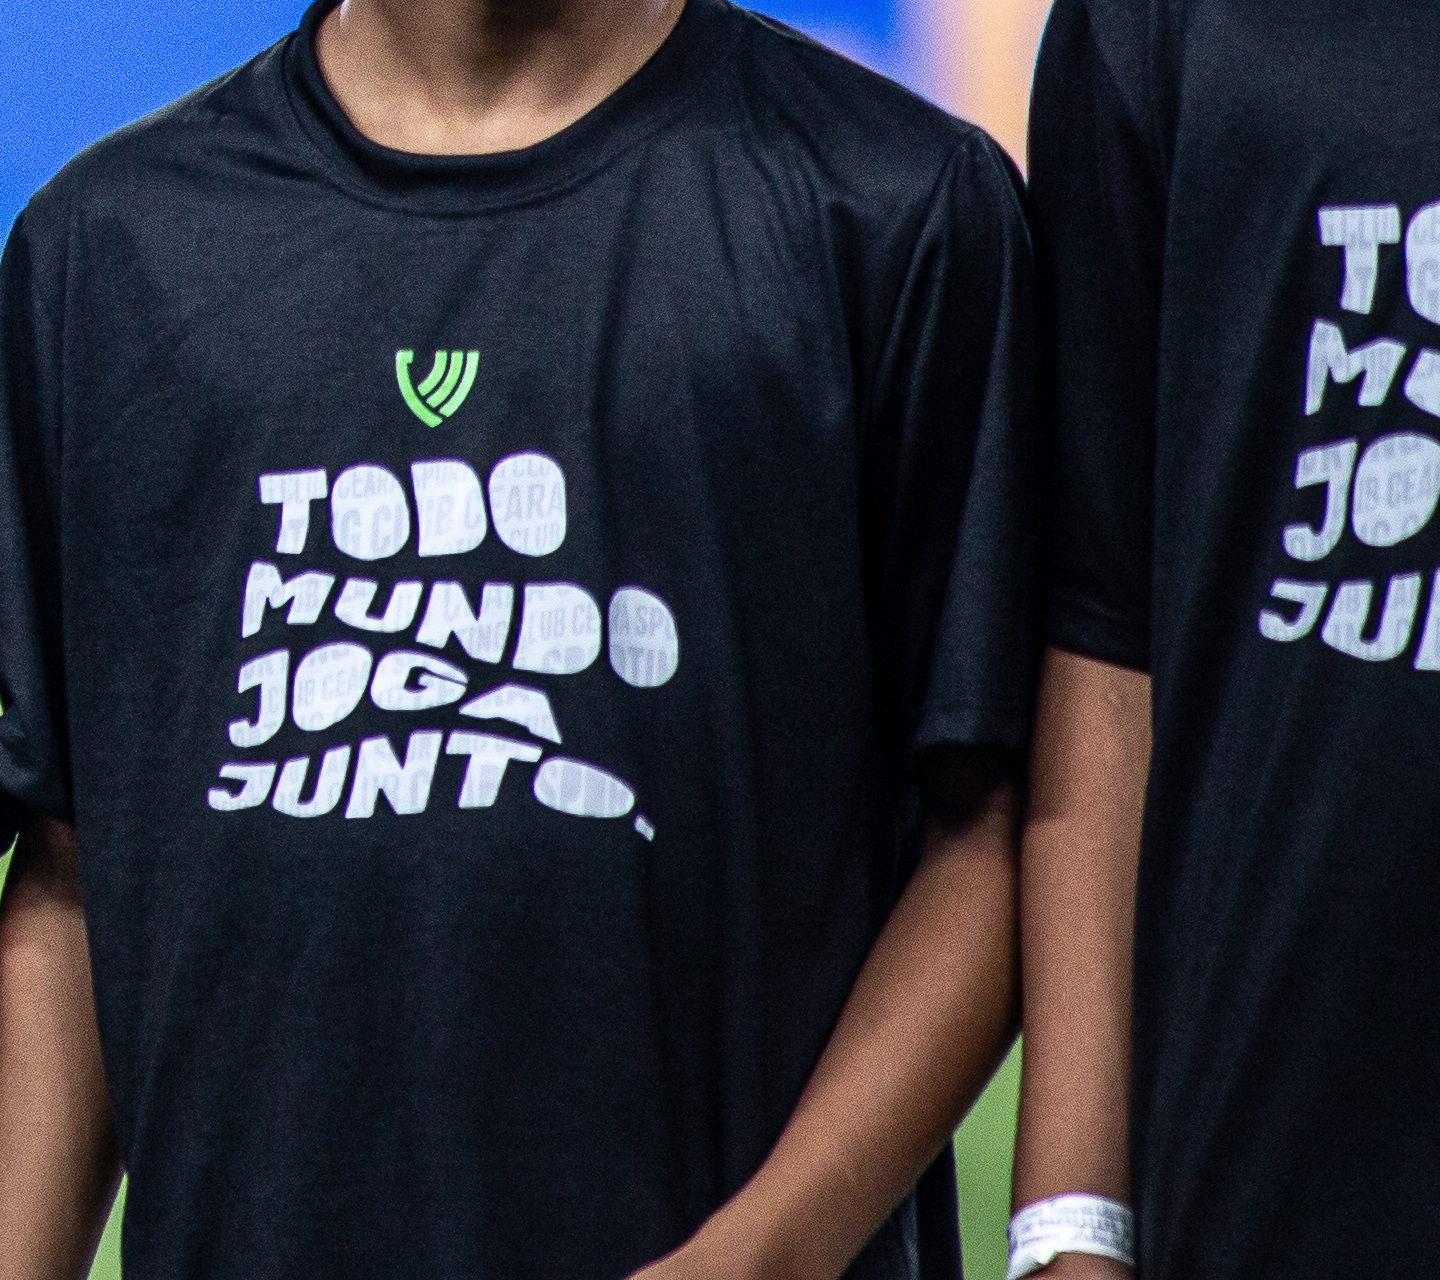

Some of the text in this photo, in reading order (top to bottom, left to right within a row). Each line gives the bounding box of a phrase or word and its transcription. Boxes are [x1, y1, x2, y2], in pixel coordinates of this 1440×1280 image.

[258, 451, 567, 561] TODO
[241, 559, 679, 688] MUNDO
[228, 641, 563, 748] JOGA
[207, 731, 655, 841] JUNTO.
